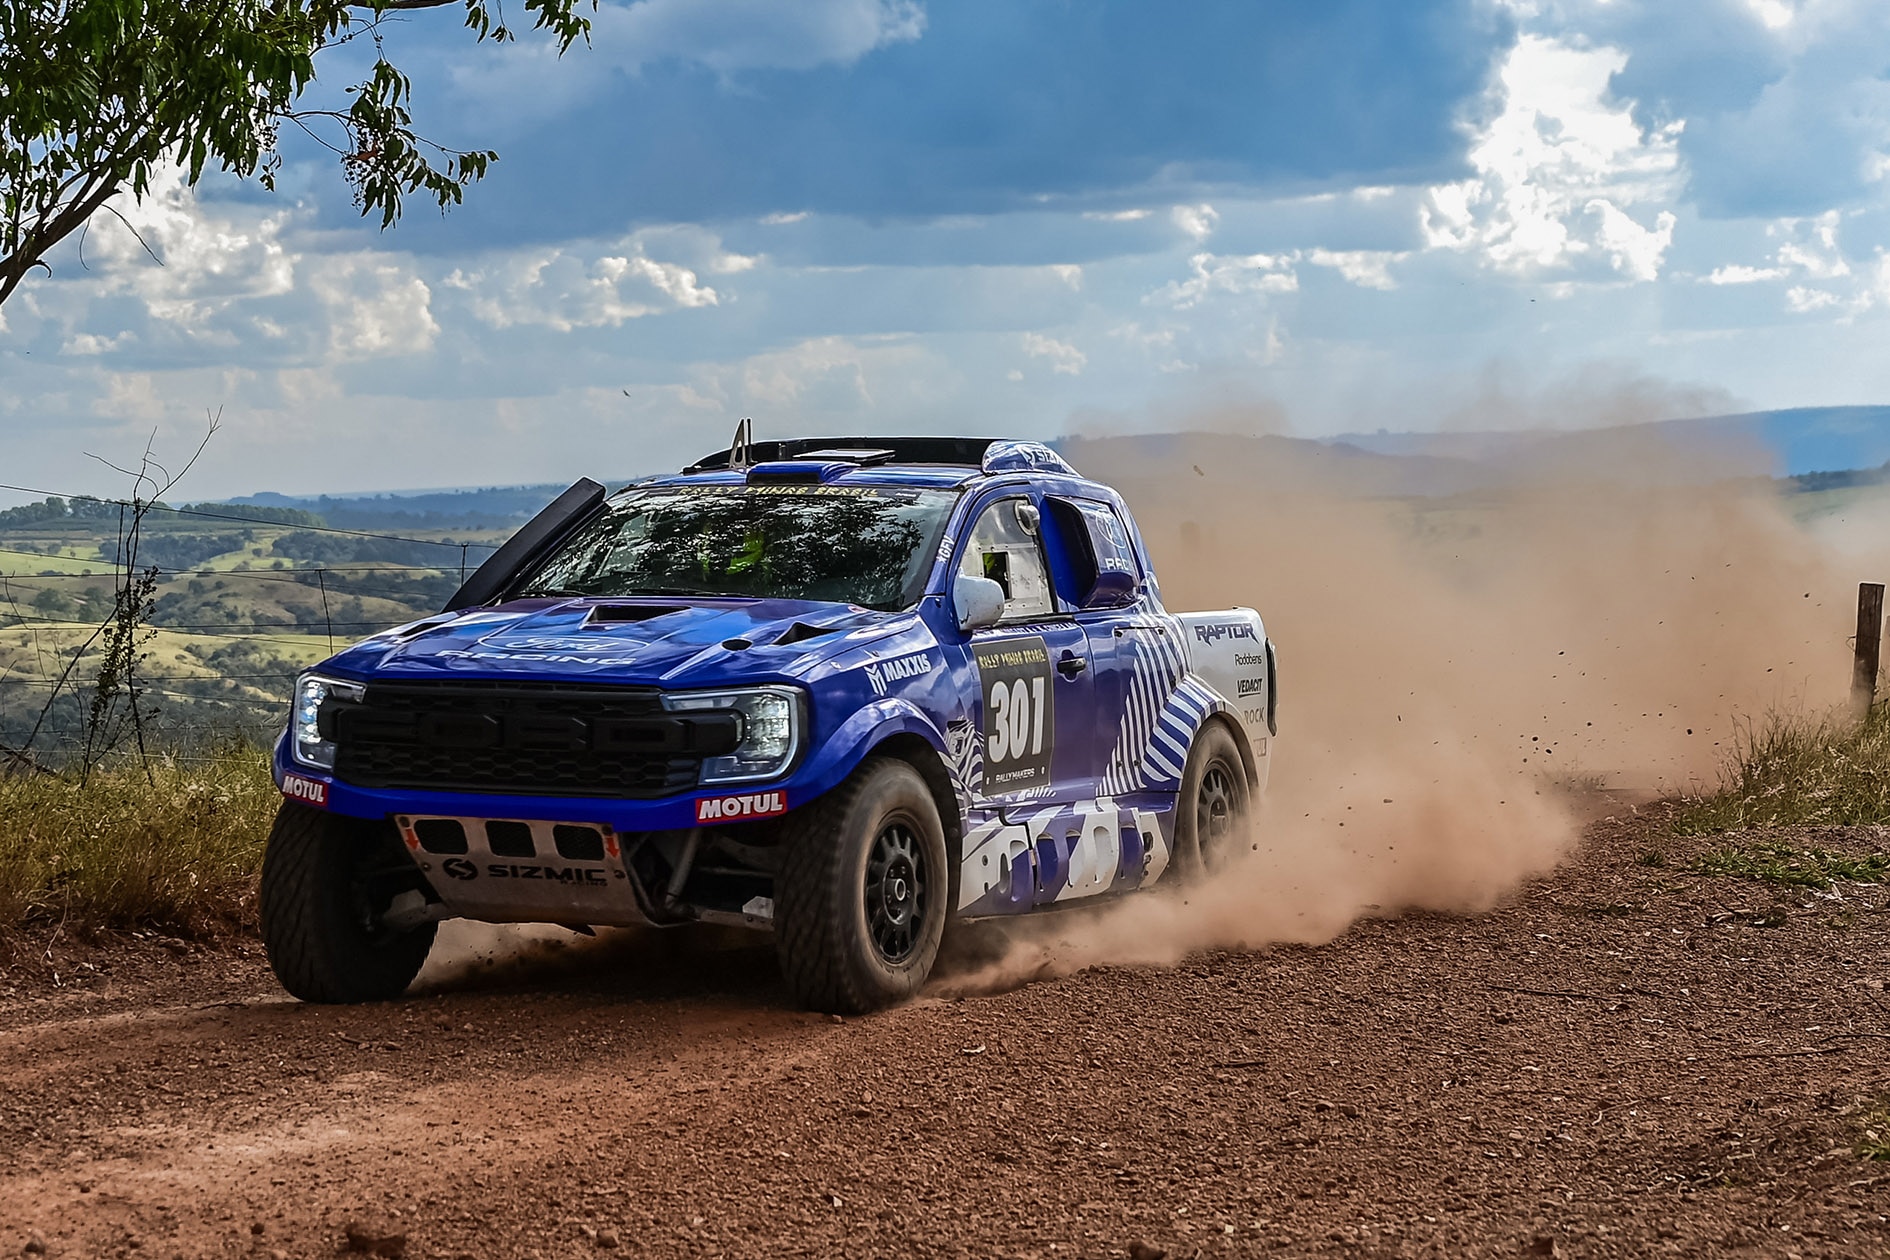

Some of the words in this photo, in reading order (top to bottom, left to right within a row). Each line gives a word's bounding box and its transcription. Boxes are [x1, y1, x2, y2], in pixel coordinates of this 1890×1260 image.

[677, 486, 739, 496] RALLY
[813, 487, 879, 498] BRASIL
[506, 636, 619, 651] Ford
[1194, 622, 1260, 648] RAPTOR
[434, 650, 637, 665] RACING
[977, 654, 1000, 670] RALLY
[1234, 653, 1262, 666] Rodobens
[881, 652, 932, 683] MAXXIS
[1237, 678, 1263, 693] VEDACIT
[988, 676, 1045, 763] 301
[282, 775, 324, 803] MOTUL
[699, 793, 783, 819] MOTUL
[487, 864, 607, 882] SIZMIC
